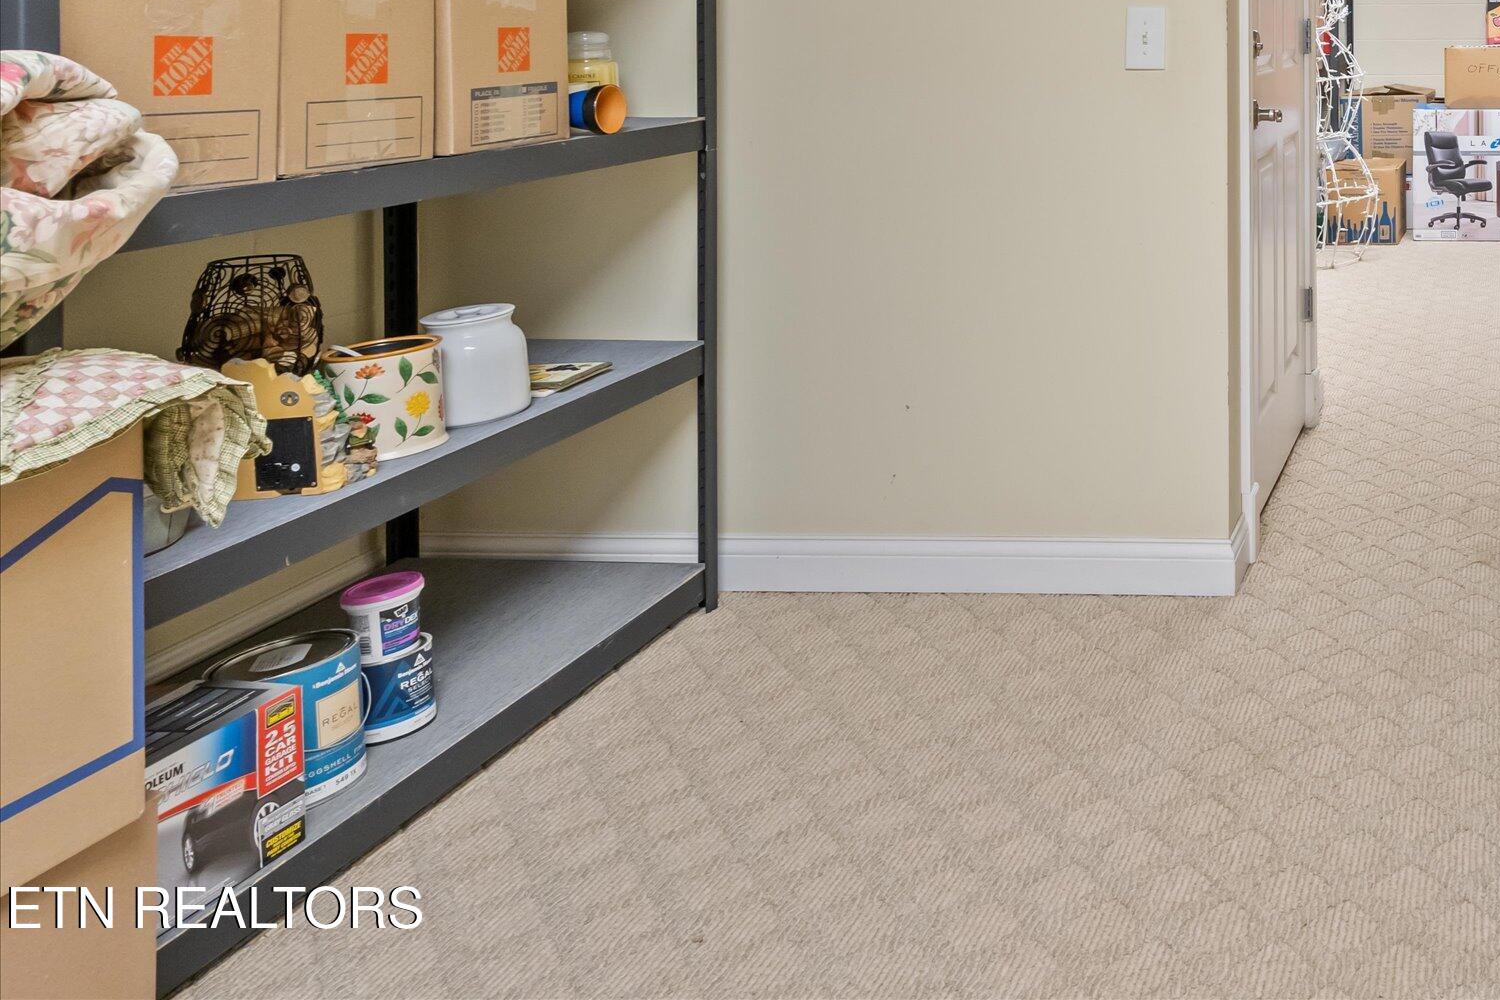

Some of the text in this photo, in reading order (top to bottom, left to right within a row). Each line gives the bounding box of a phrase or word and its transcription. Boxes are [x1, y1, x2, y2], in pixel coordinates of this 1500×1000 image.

[153, 36, 213, 96] HOME
[160, 43, 184, 65] THE
[345, 33, 388, 85] HOME
[400, 667, 432, 690] REGAL
[322, 703, 358, 727] REGAL
[265, 720, 296, 749] 2.5
[265, 735, 296, 758] CAR
[265, 745, 296, 766] GARAGE
[265, 752, 297, 777] KIT
